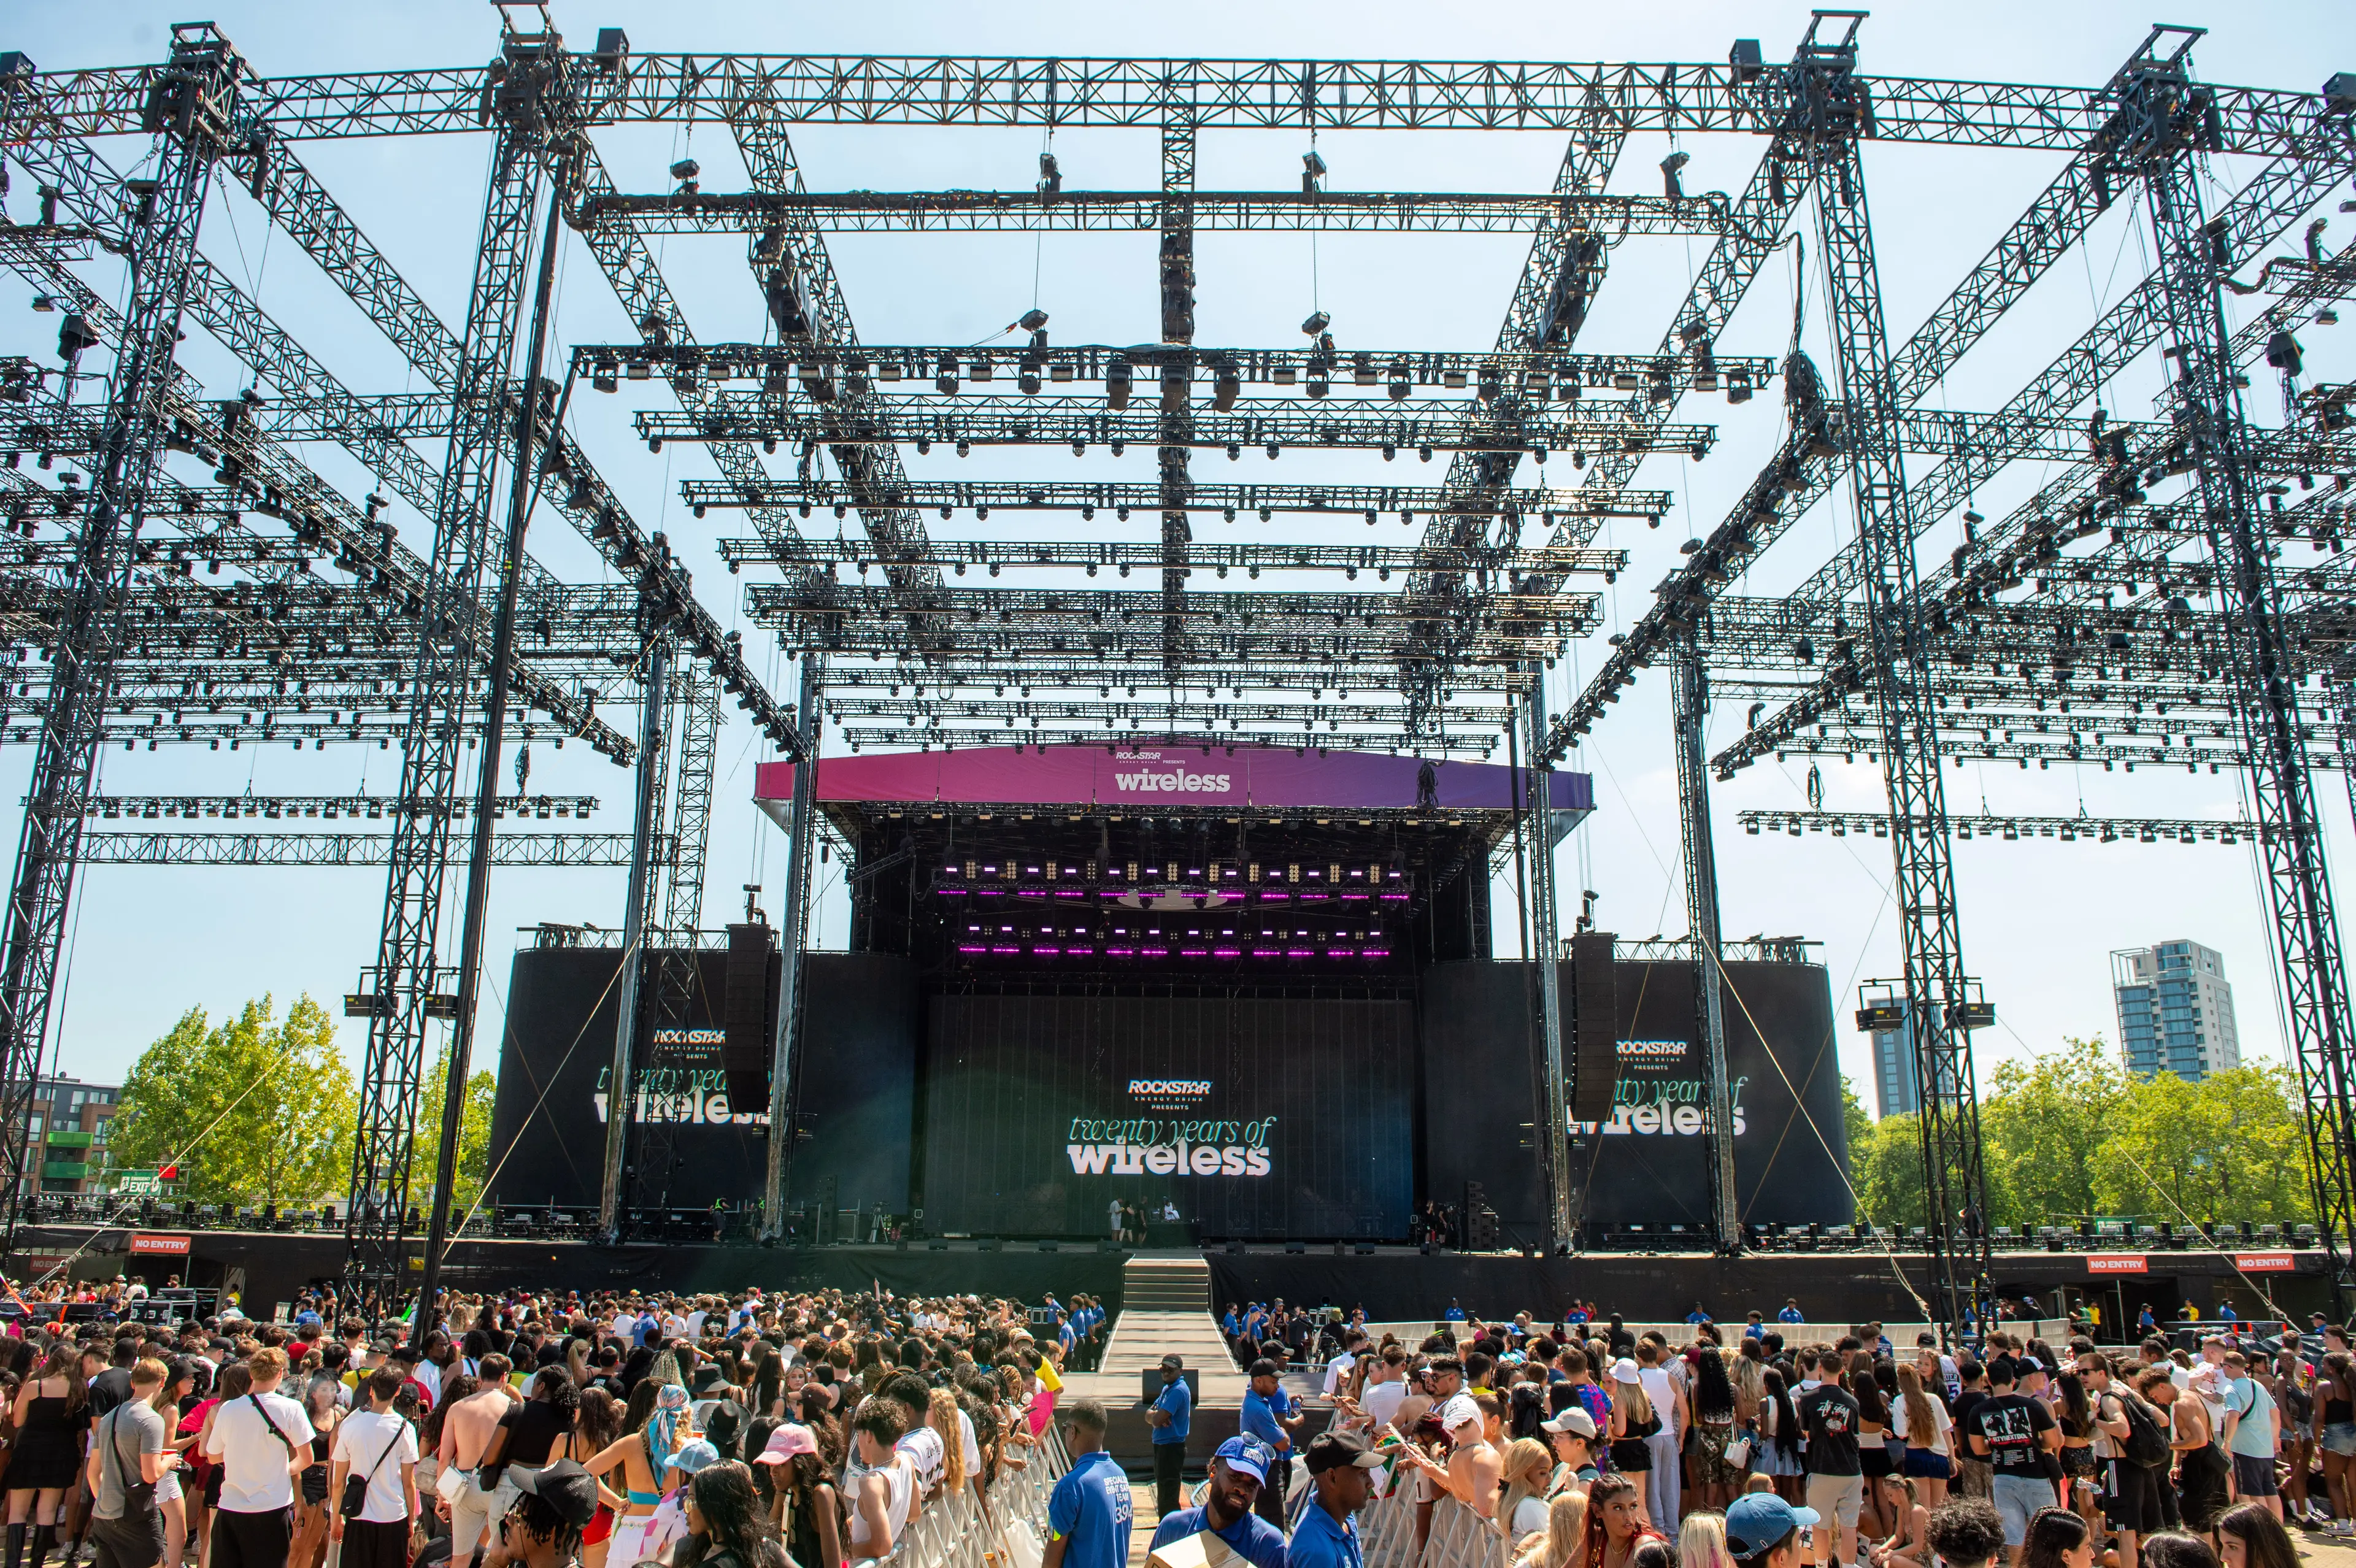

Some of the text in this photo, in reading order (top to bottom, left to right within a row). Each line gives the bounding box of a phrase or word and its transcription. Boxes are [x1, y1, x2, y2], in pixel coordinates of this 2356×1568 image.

[1115, 769, 1230, 792] wireless
[1128, 1080, 1211, 1094] ROCKSTAR
[1069, 1116, 1277, 1150] twenty years of
[1066, 1136, 1271, 1176] wireless
[129, 1182, 150, 1192] EXIT
[150, 1240, 188, 1249] ENTRY
[2108, 1260, 2143, 1269] ENTRY
[2256, 1258, 2290, 1267] ENTRY
[1242, 1450, 1265, 1467] SECURITY
[1116, 1492, 1129, 1502] TEAM
[1115, 1504, 1133, 1523] 394
